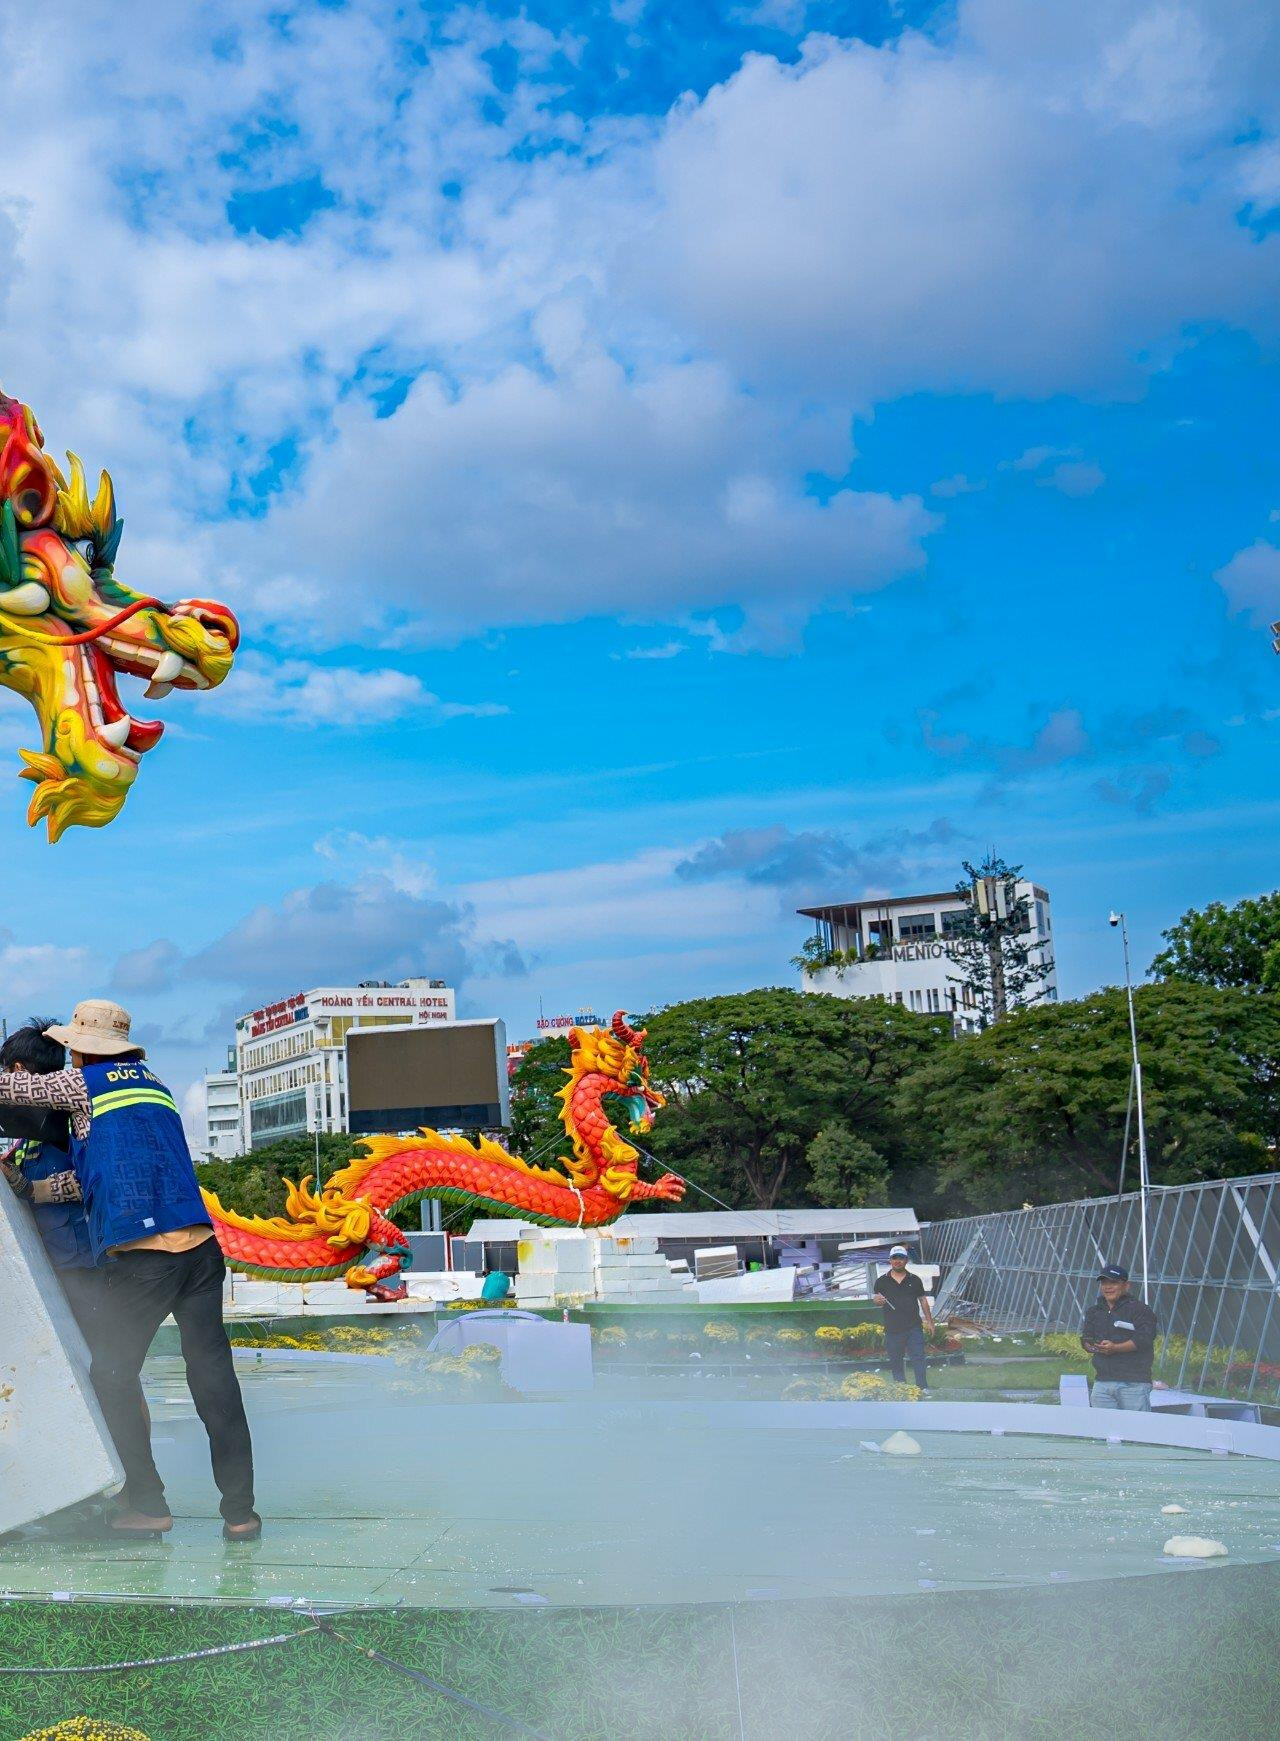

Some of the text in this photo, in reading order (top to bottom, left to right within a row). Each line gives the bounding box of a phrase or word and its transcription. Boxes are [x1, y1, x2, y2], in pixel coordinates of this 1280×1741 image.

[893, 943, 942, 962] MENTO
[321, 994, 448, 1007] HOÀNG YẾN CENTRAL HOTEL
[106, 1067, 140, 1082] ĐỨC
